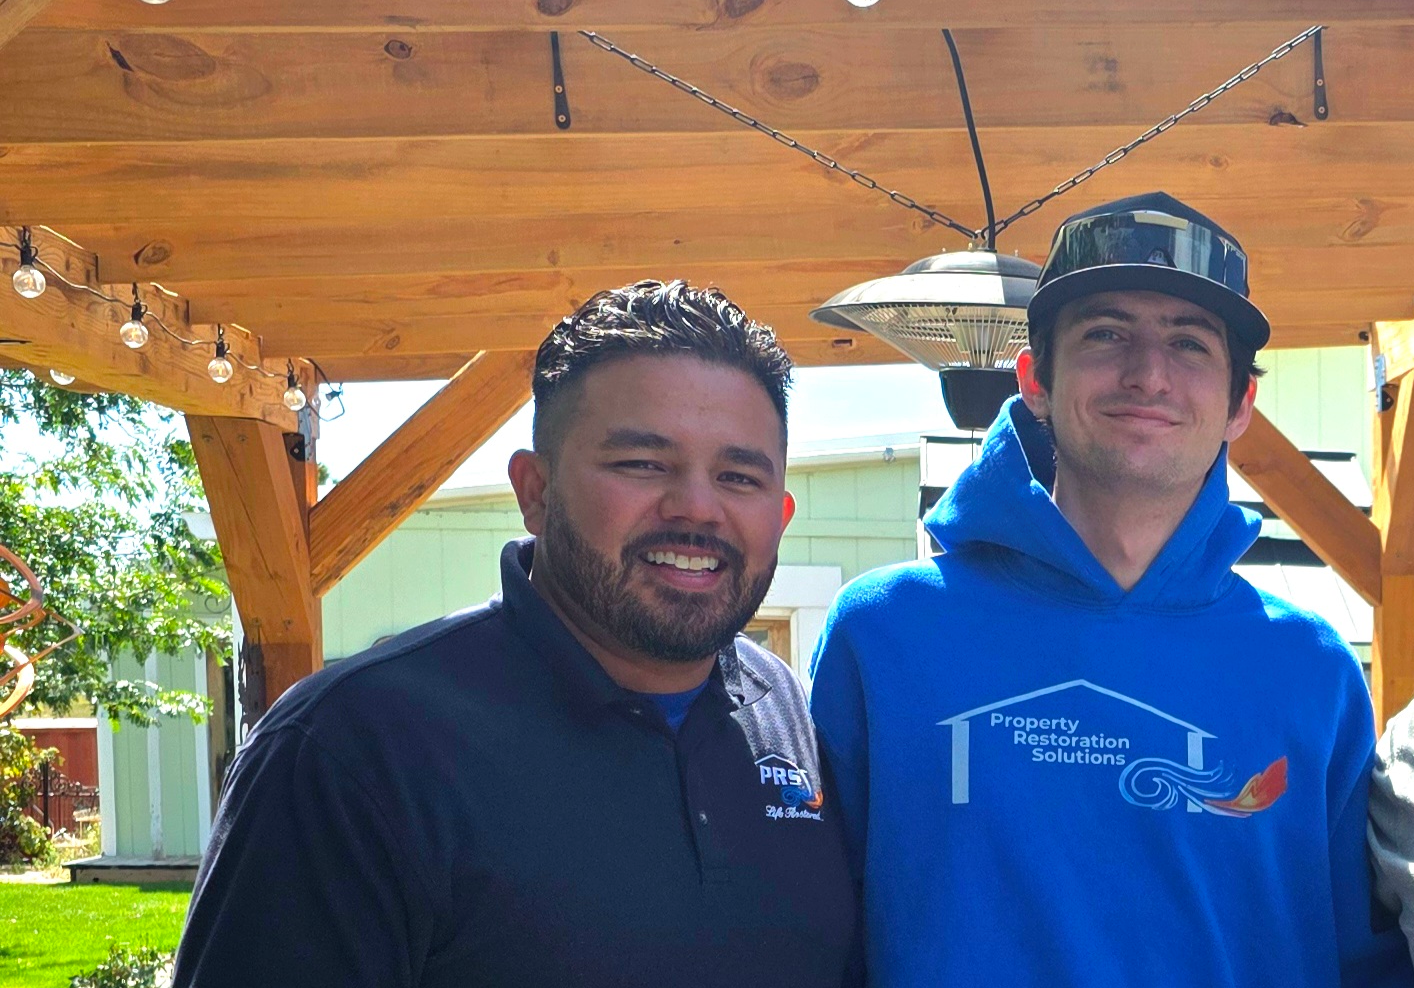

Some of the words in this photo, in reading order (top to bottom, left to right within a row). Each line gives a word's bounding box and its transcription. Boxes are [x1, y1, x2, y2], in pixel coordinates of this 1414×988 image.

[990, 712, 1080, 734] Property
[1013, 730, 1130, 749] Restoration
[1031, 747, 1126, 766] Solutions
